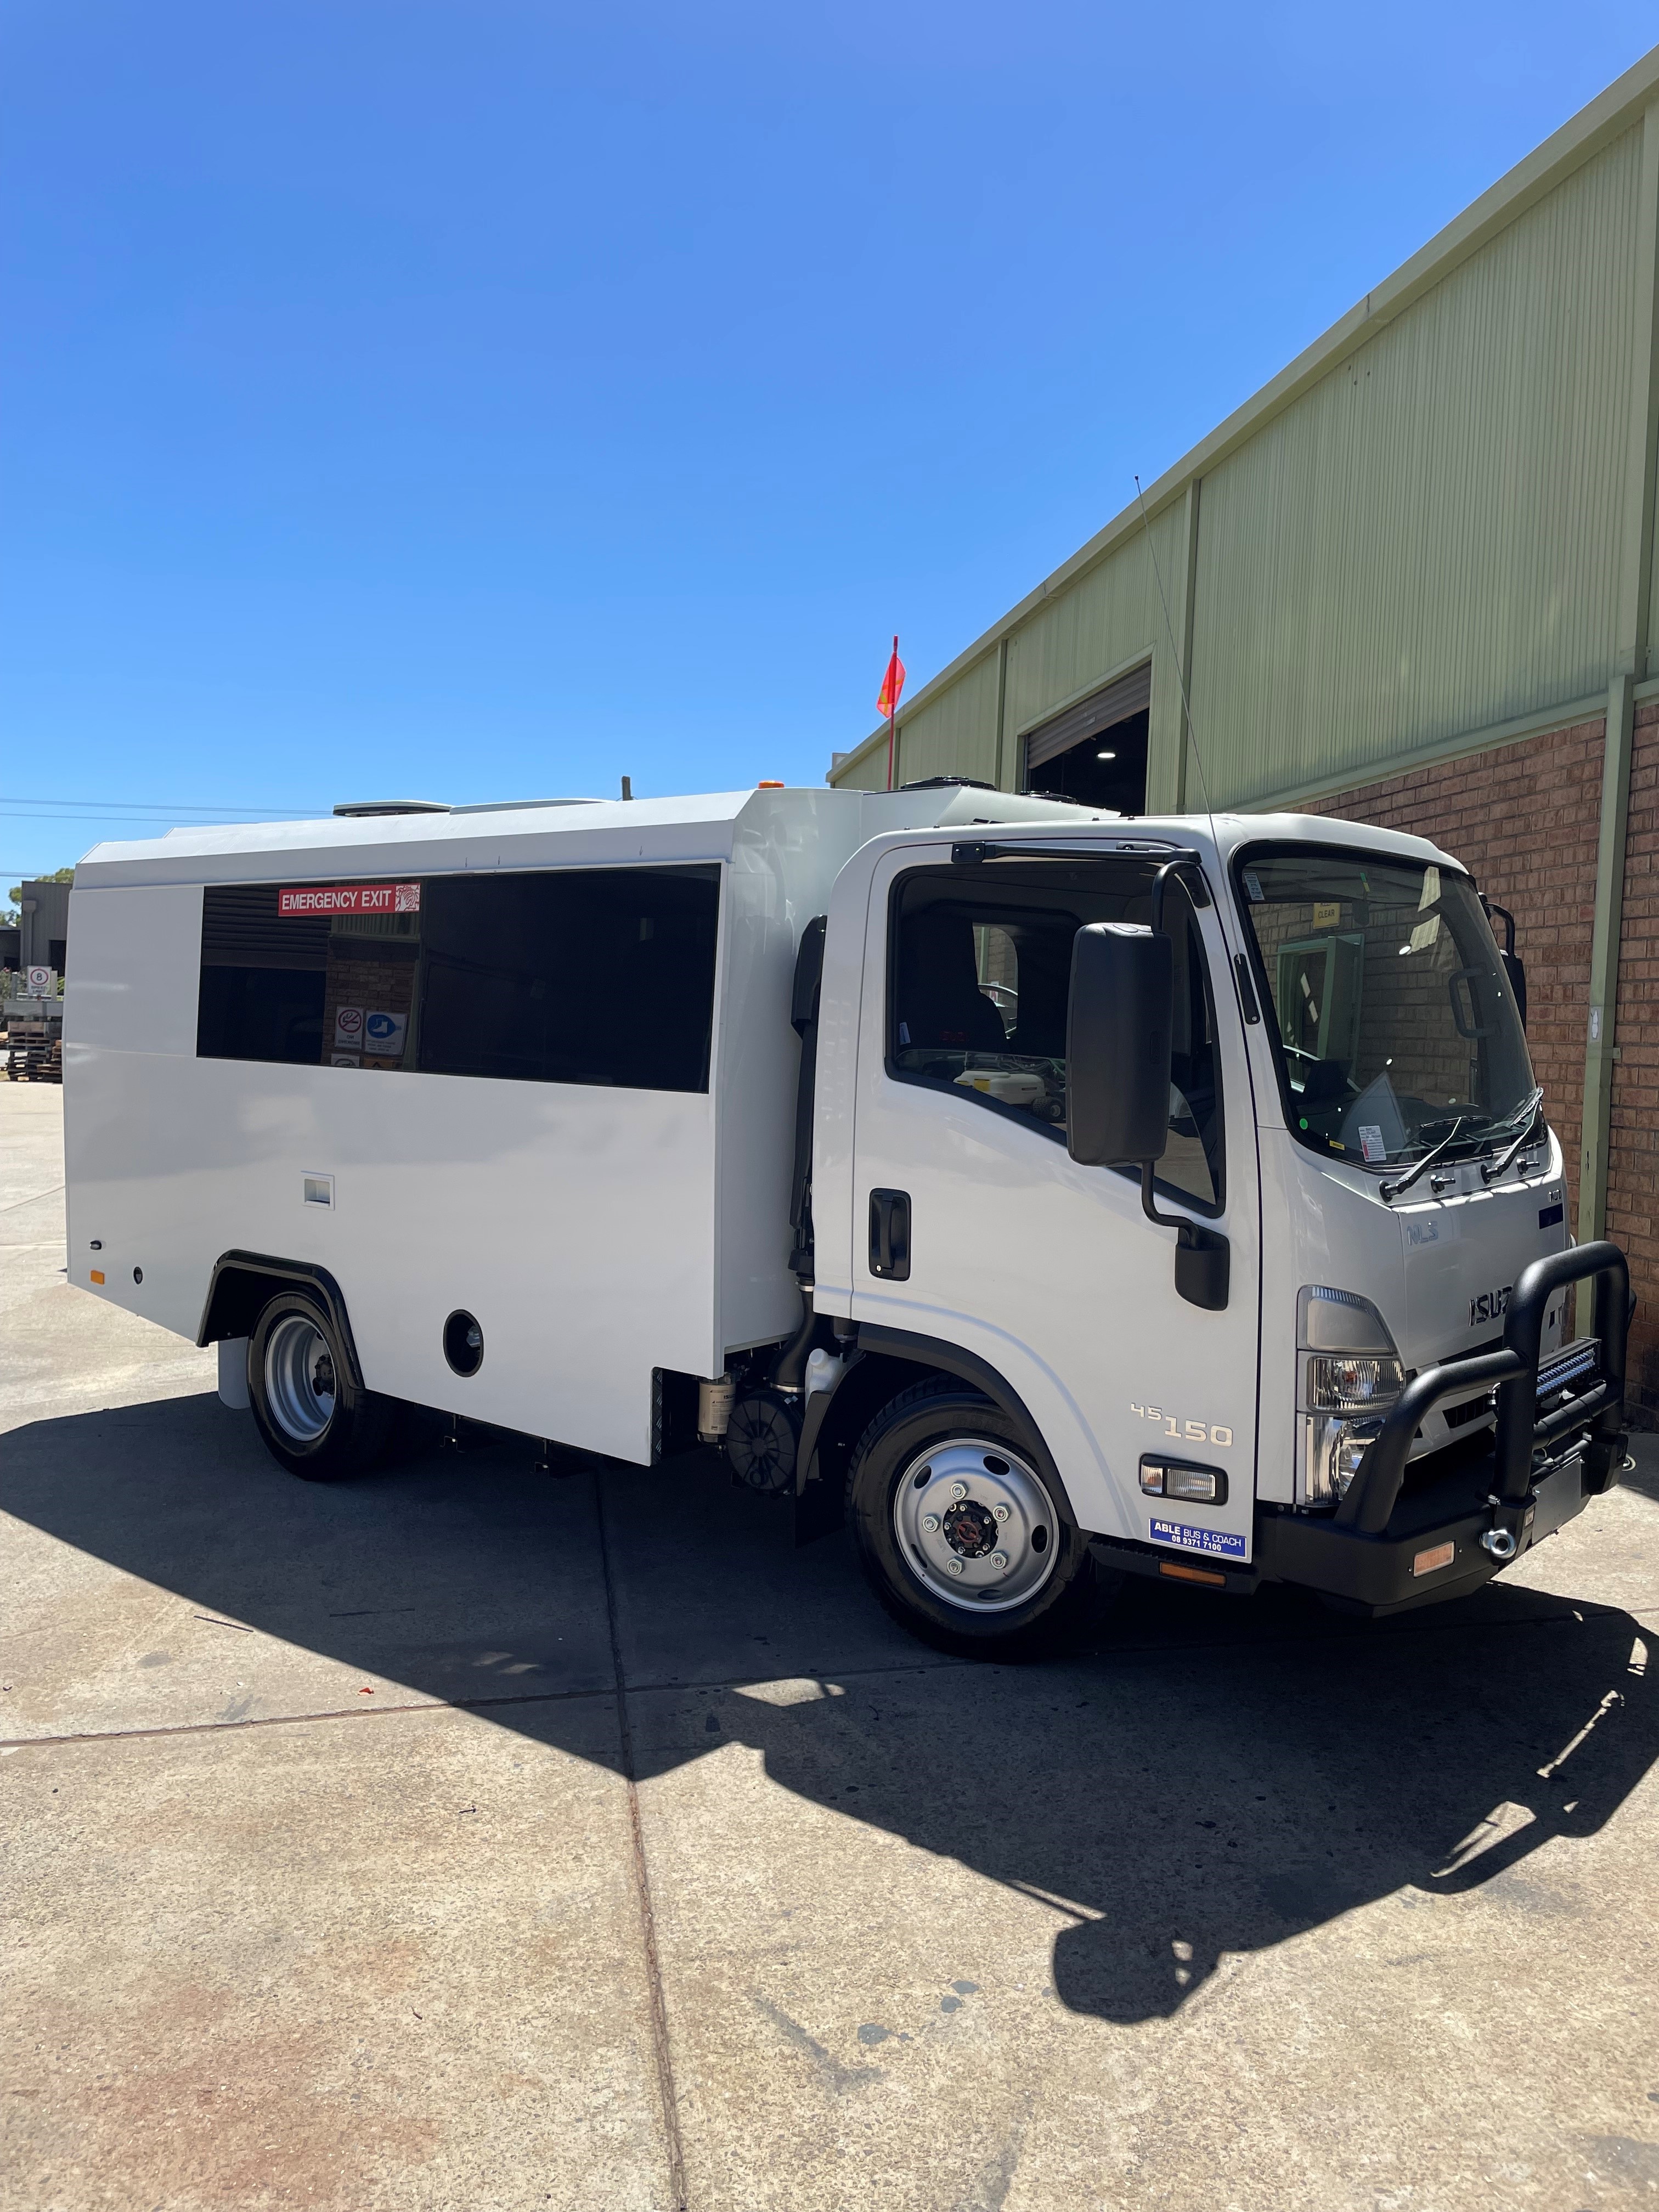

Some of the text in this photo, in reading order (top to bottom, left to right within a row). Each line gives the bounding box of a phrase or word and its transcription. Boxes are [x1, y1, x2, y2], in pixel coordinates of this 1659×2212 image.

[281, 890, 392, 910] EMERGENCY EXIT
[1318, 909, 1335, 919] CLEAR
[36, 973, 42, 981] 8
[1407, 1220, 1438, 1246] NLS
[1469, 1285, 1513, 1327] ISUZ
[1131, 1402, 1233, 1447] 45 150
[1154, 1522, 1242, 1547] ABLE BUS & COACH
[1183, 1537, 1200, 1547] 9371
[1203, 1541, 1222, 1551] 7100
